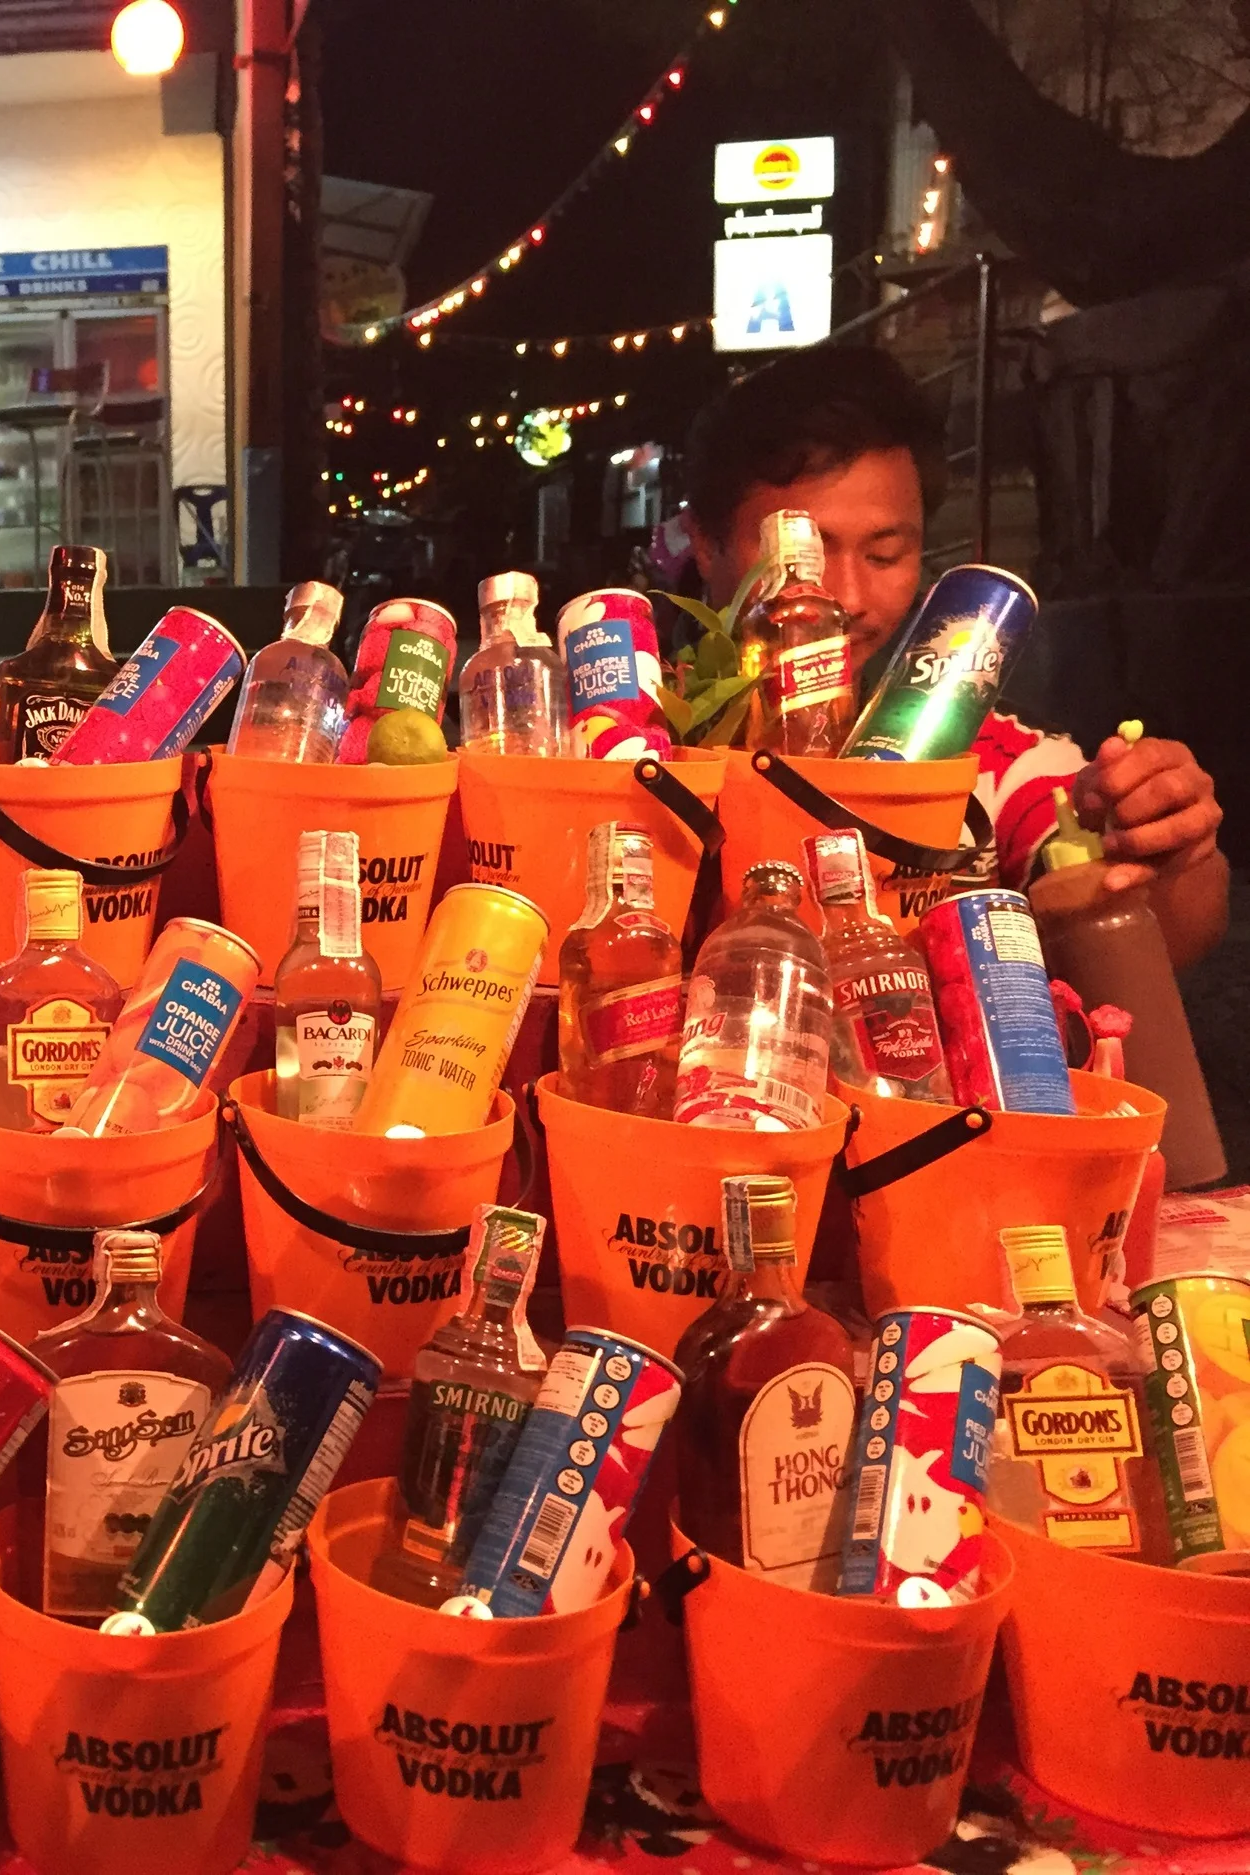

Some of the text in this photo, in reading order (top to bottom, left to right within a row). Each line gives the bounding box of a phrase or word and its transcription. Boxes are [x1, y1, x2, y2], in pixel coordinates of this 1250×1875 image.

[31, 252, 112, 271] CHILL
[18, 280, 88, 294] DRINKS
[399, 643, 443, 670] CHABAA
[573, 634, 622, 654] CHABAA
[389, 666, 441, 697] LYCHEE
[572, 655, 629, 679] RED APPLE
[909, 651, 998, 692] Spte
[387, 680, 438, 712] JUICE
[575, 670, 631, 697] JUICE
[586, 684, 618, 699] DRINK
[25, 705, 56, 729] JACK
[397, 694, 427, 713] DRINK
[358, 854, 425, 886] SOLUT
[468, 840, 516, 872] OLUT
[85, 888, 153, 924] VODKA
[360, 895, 408, 924] DKA
[984, 914, 996, 951] CHABAA
[180, 980, 228, 1016] CHABAA
[416, 970, 515, 1003] Schweppes
[164, 1000, 221, 1042] ORANGE
[303, 1026, 371, 1043] BACARDI
[623, 1011, 650, 1027] Red
[21, 1038, 101, 1063] GORDON'S
[148, 1037, 167, 1051] WITH
[156, 1015, 215, 1060] JUICE
[164, 1035, 196, 1060] DRINK
[405, 1029, 487, 1058] Sparkling
[892, 1048, 926, 1059] VODKA
[30, 1062, 62, 1072] LONDON
[64, 1062, 80, 1071] DRY
[400, 1049, 478, 1092] TONIC WATER
[615, 1212, 720, 1257] ABSOL
[41, 1277, 97, 1307] VOD
[366, 1269, 462, 1305] VODKA
[627, 1258, 721, 1300] VODK
[432, 1384, 523, 1423] SMIRNO
[1021, 1408, 1123, 1436] GORDON'S
[170, 1413, 276, 1492] Sprite
[1034, 1435, 1116, 1446] LONDON DRY GIN
[774, 1443, 841, 1480] HONG
[768, 1465, 846, 1506] THONG
[1129, 1670, 1250, 1717] ABSOL
[381, 1702, 547, 1756] ABSOLUT
[859, 1703, 964, 1741] ABSOL
[62, 1729, 223, 1773] ABSOLUT
[1145, 1718, 1250, 1759] VODK
[395, 1753, 523, 1801] VODKA
[79, 1780, 203, 1818] VODKA
